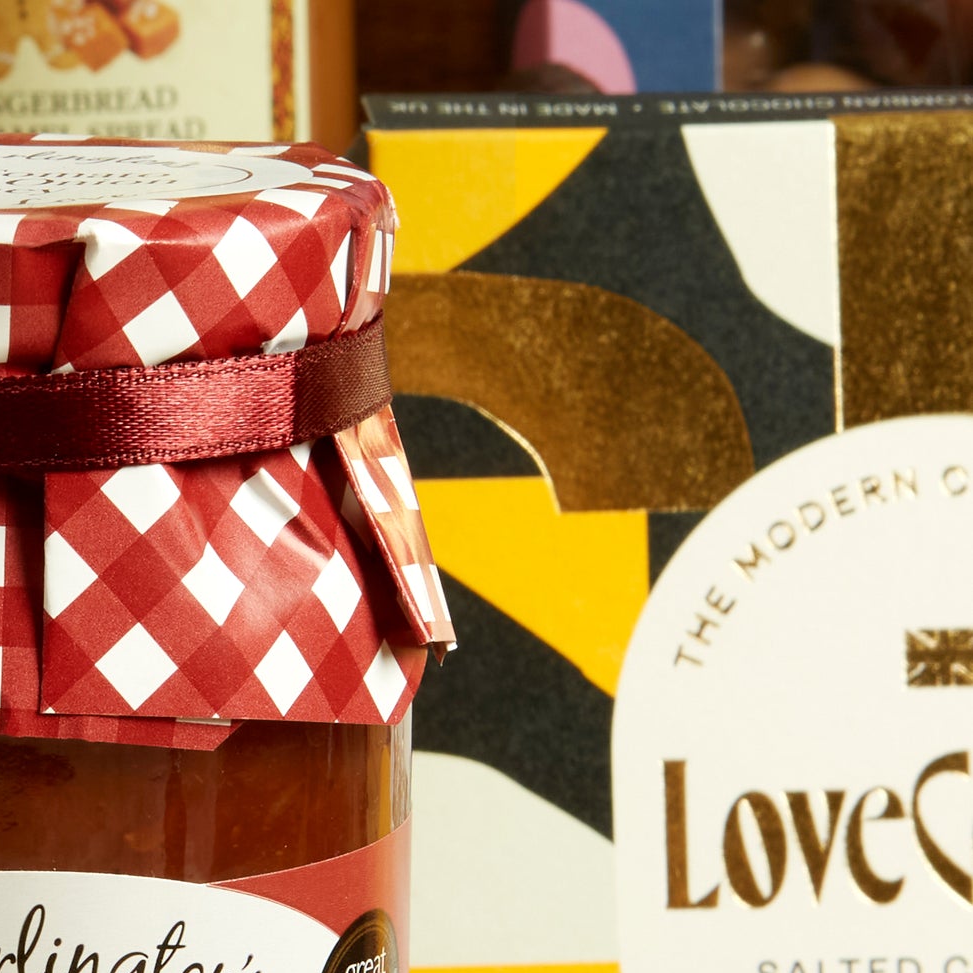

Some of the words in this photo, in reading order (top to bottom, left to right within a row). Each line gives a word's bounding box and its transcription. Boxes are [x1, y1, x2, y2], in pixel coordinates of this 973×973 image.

[436, 101, 491, 117] THE
[498, 101, 528, 116] IN
[535, 100, 619, 116] MADE
[673, 583, 738, 669] THE
[730, 466, 920, 583] MODERN
